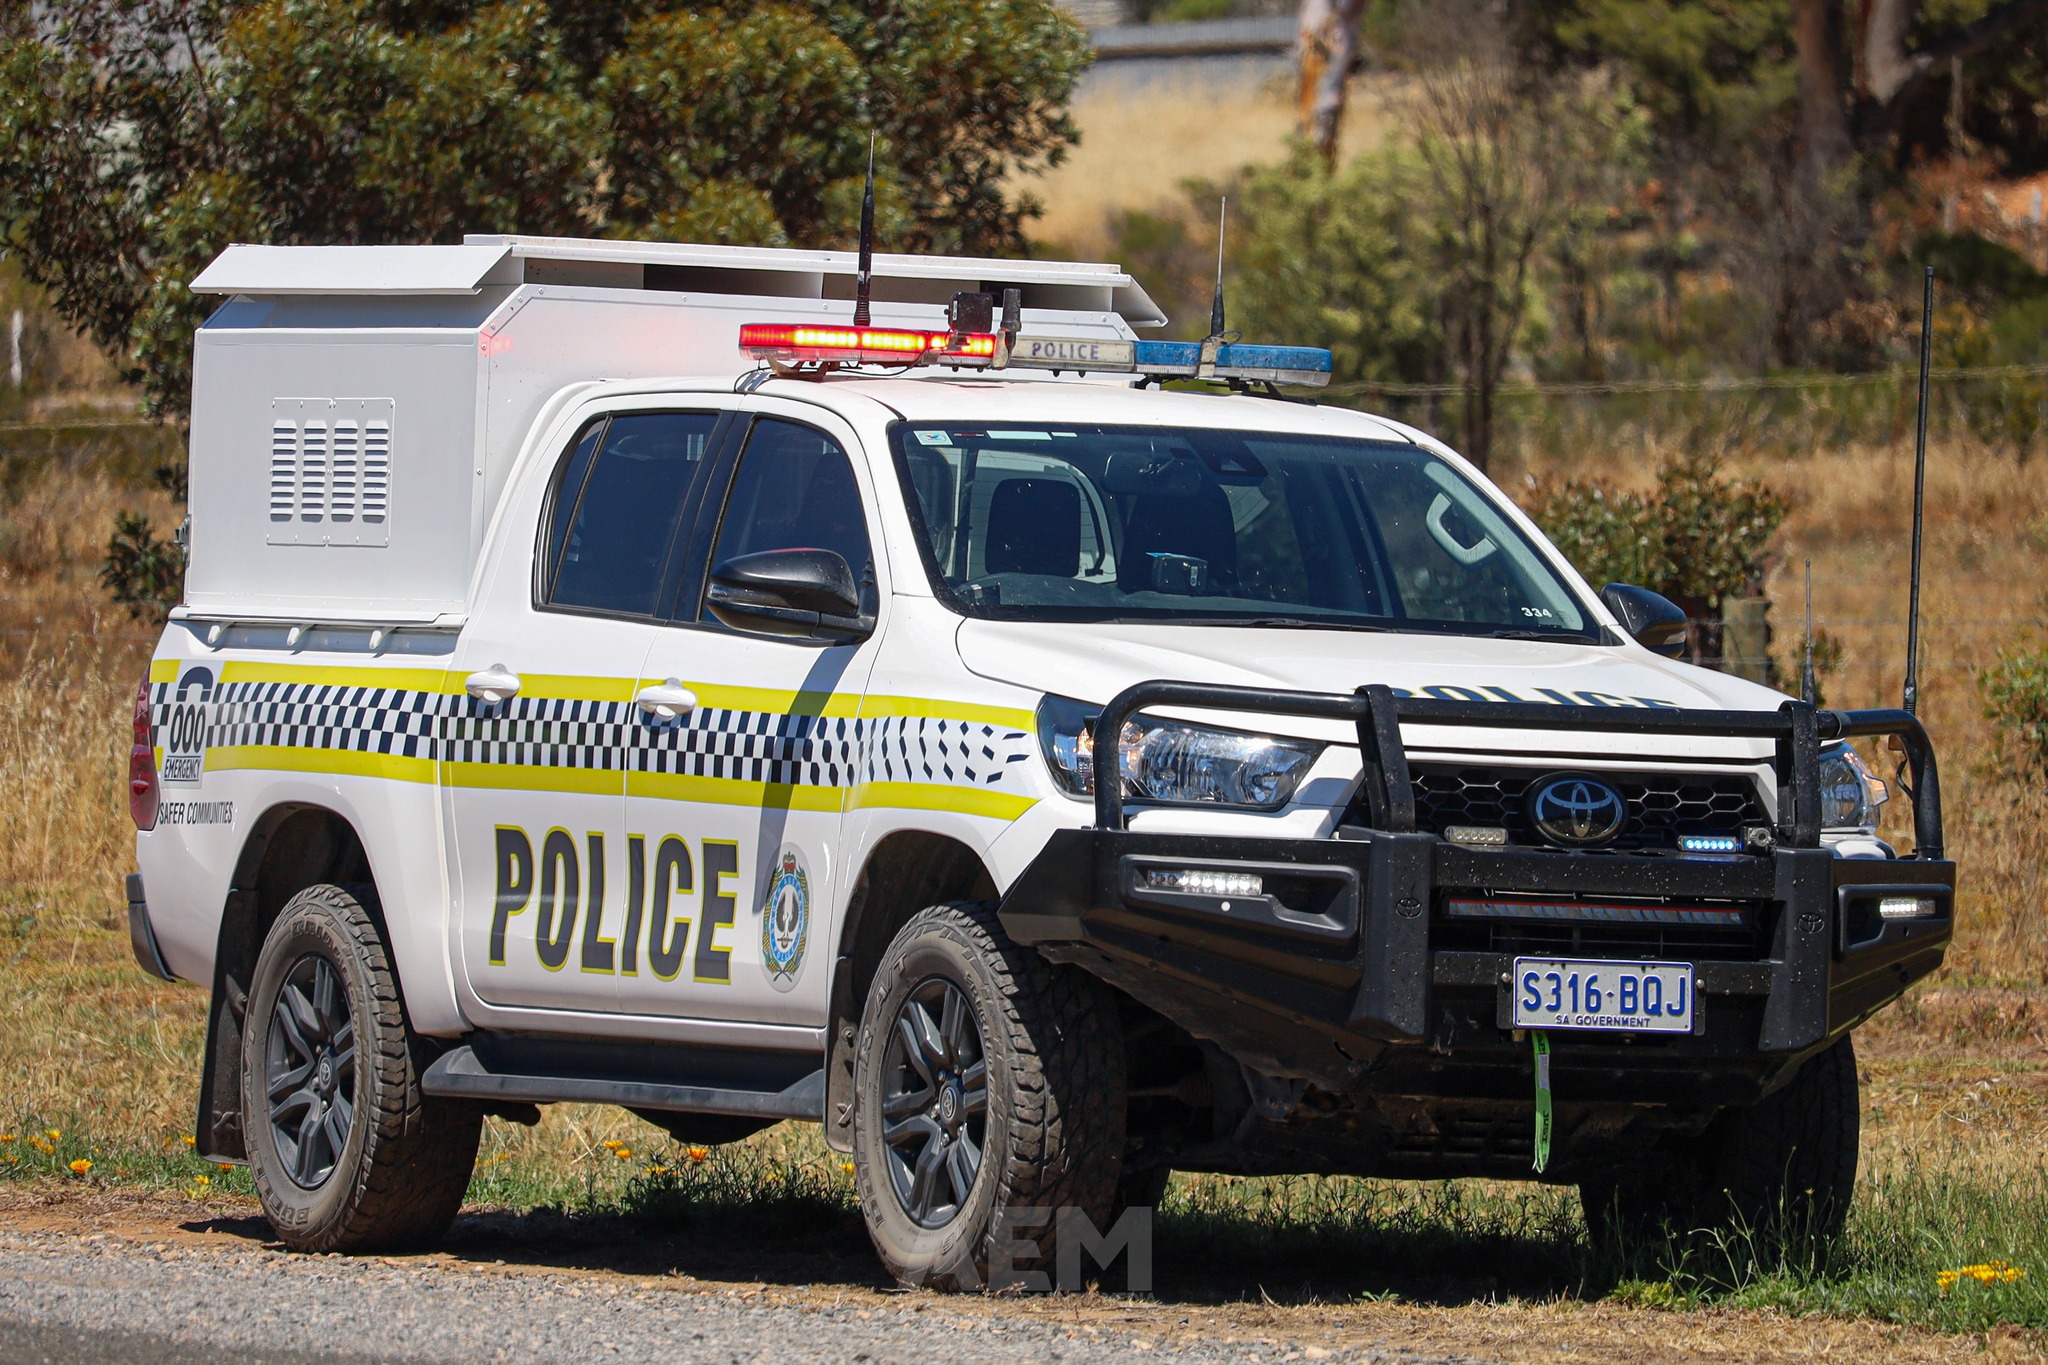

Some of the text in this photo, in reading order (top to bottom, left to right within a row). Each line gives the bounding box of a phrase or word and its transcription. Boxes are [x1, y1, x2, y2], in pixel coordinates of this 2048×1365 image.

[1032, 342, 1099, 360] POLICE
[1520, 606, 1552, 618] 334
[169, 703, 206, 754] 000
[164, 758, 201, 779] EMERGENCY
[159, 801, 233, 824] SAFER COMMUNITIES
[488, 824, 739, 985] POLICE
[1555, 1015, 1651, 1028] SA GOVERNMENT
